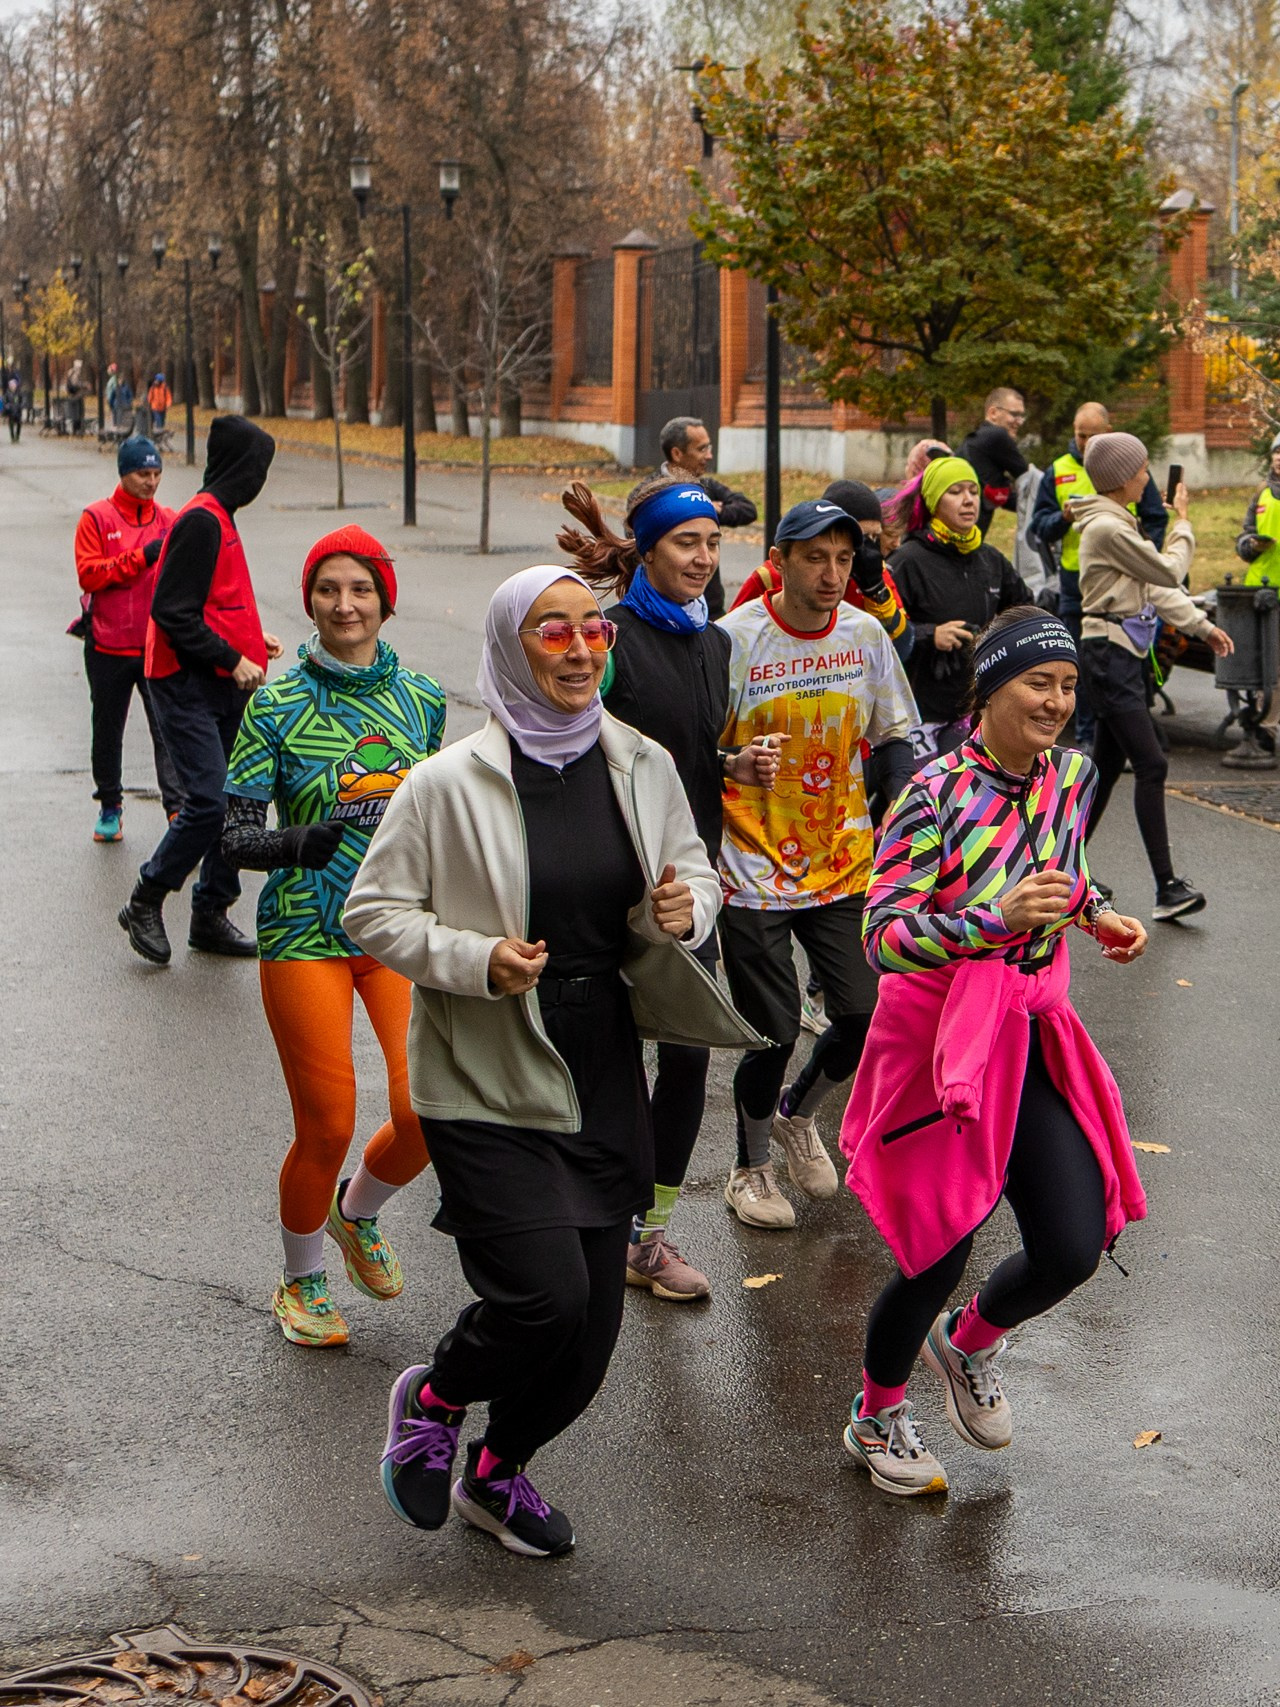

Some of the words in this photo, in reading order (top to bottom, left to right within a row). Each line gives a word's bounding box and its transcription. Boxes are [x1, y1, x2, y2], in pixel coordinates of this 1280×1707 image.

[1015, 630, 1076, 648] ЛЕНИНОГОР
[749, 661, 787, 682] БЕЗ
[791, 649, 864, 675] ГРАНИЦ
[748, 667, 864, 696] БЛАГОТВОРИТЕЛЬНЫЙ
[795, 687, 829, 701] ЗАБЕГ
[330, 799, 389, 819] МЫТИ
[358, 815, 383, 826] БЕГУ
